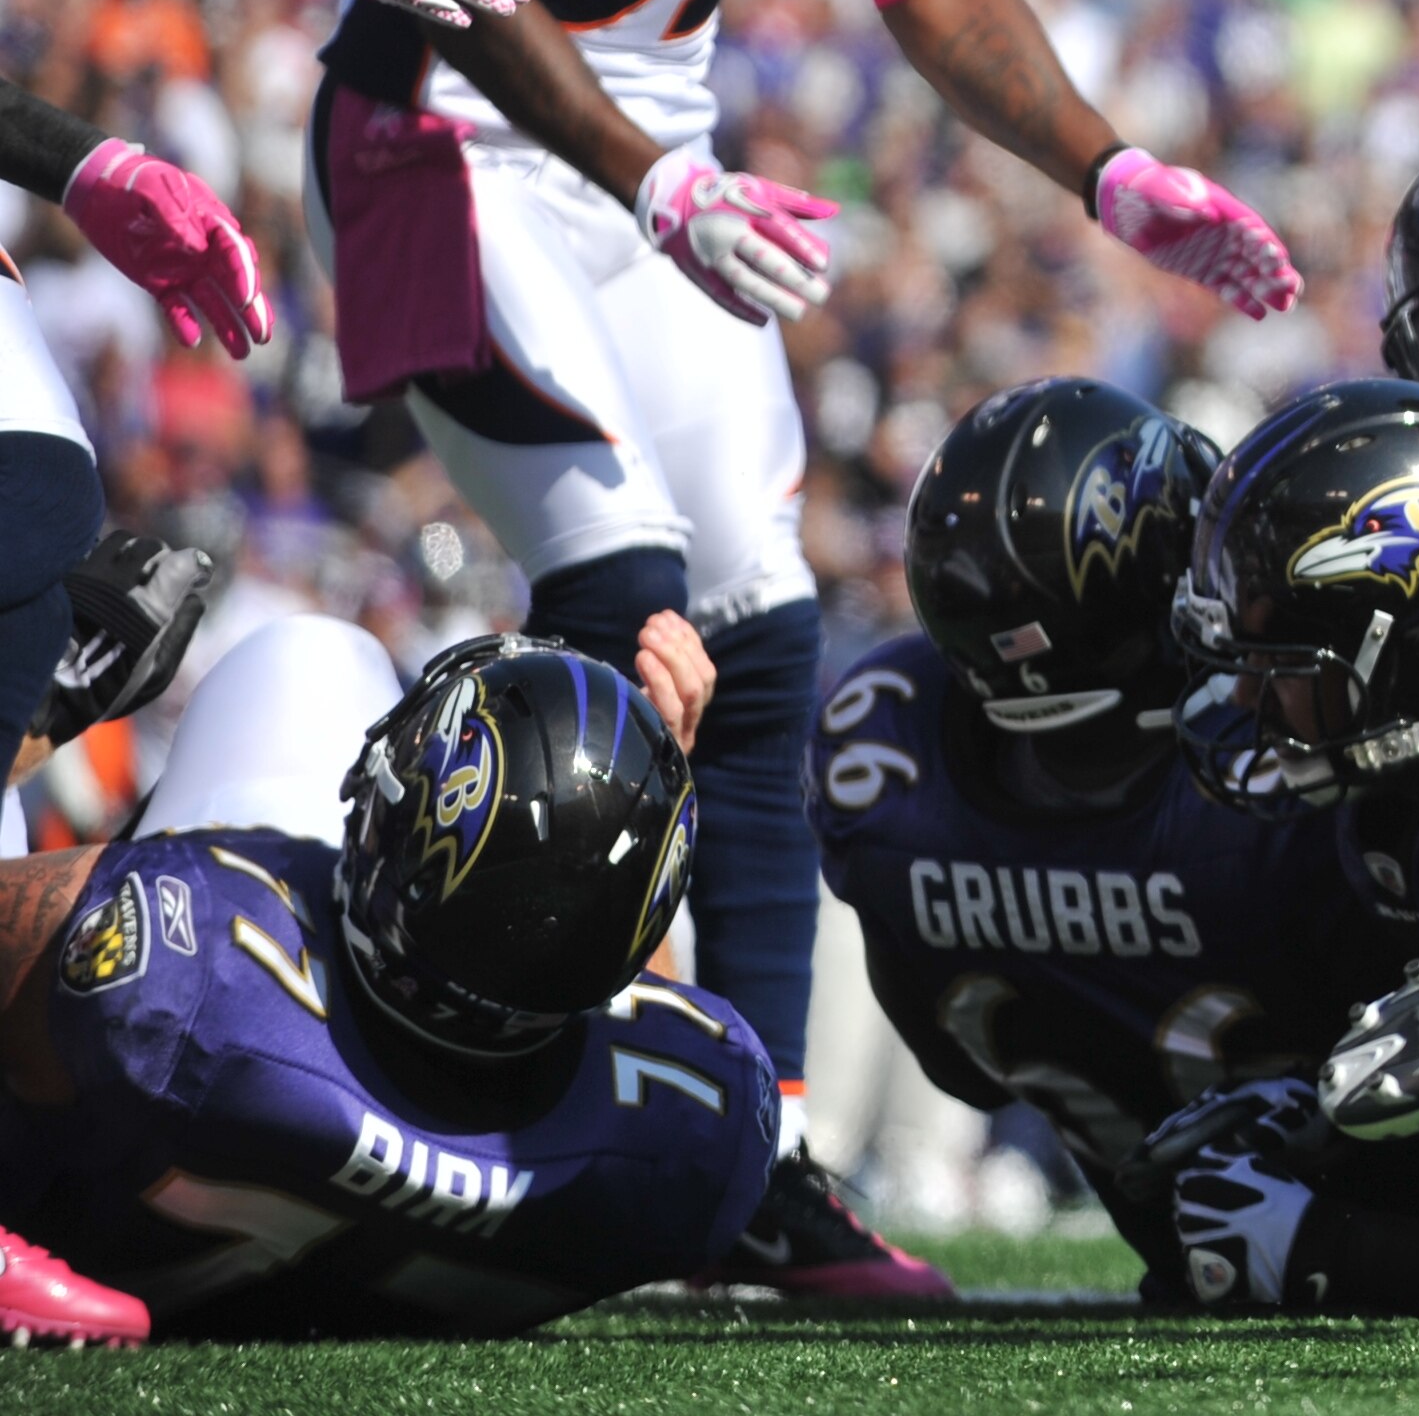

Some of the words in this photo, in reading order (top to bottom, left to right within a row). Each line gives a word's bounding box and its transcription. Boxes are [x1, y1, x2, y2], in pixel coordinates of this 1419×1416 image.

[1077, 465, 1127, 540] B
[823, 668, 920, 812] 66
[119, 881, 138, 968] RAVENS
[909, 856, 1202, 958] GRUBBS
[608, 983, 727, 1117] 77
[328, 1110, 536, 1239] BIRK
